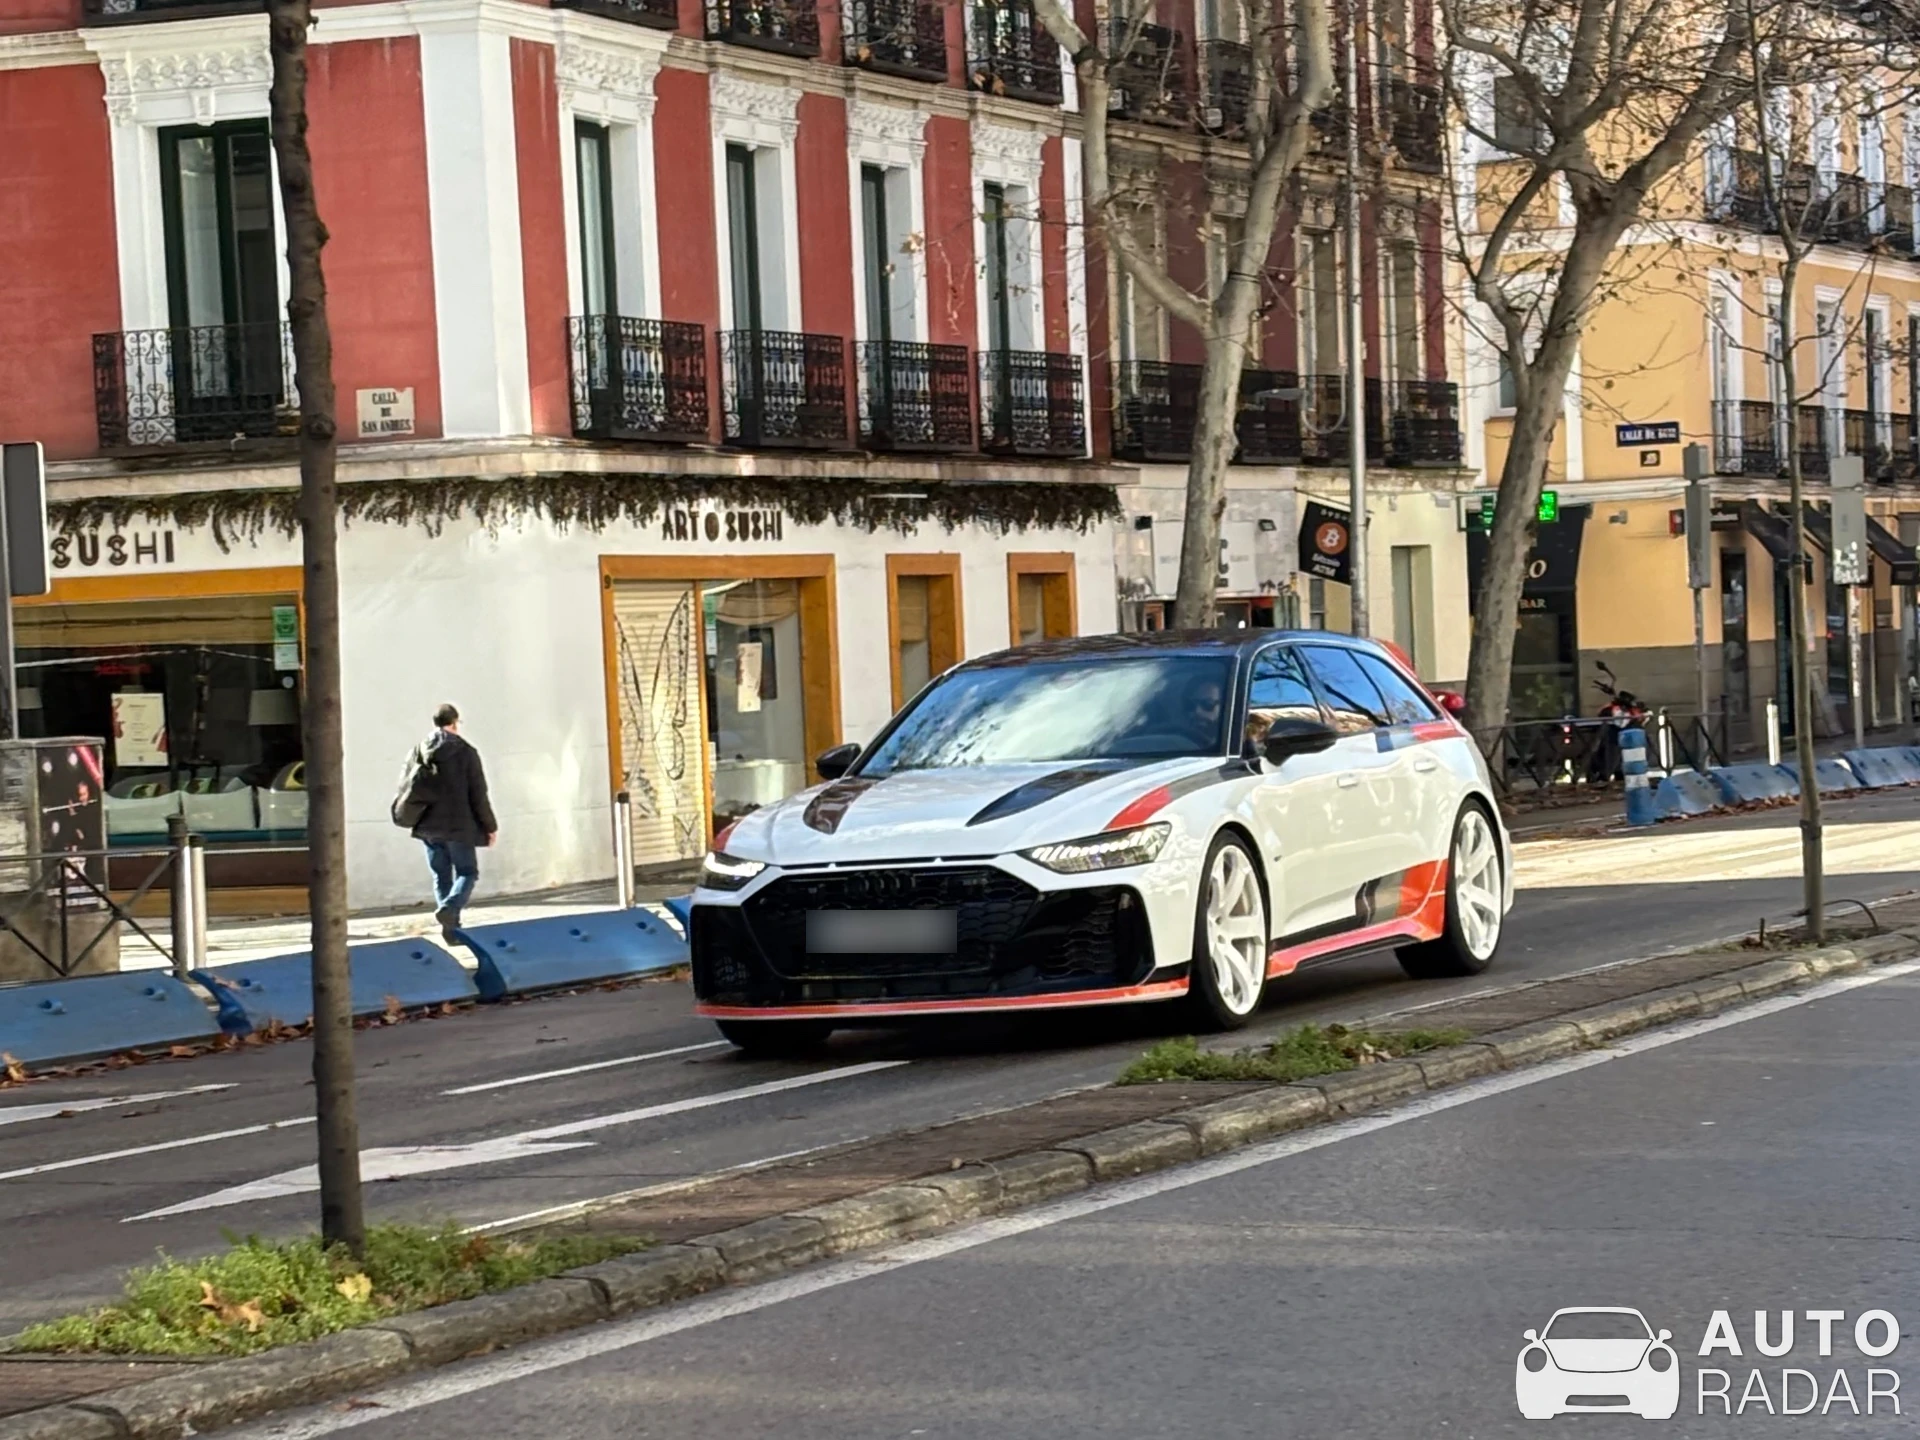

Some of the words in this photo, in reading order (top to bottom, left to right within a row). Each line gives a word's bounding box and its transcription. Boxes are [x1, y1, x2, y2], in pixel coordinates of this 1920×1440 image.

[361, 420, 377, 433] SAN
[661, 502, 699, 541] ART
[724, 510, 783, 542] SUSHI
[50, 529, 175, 569] SUSHI
